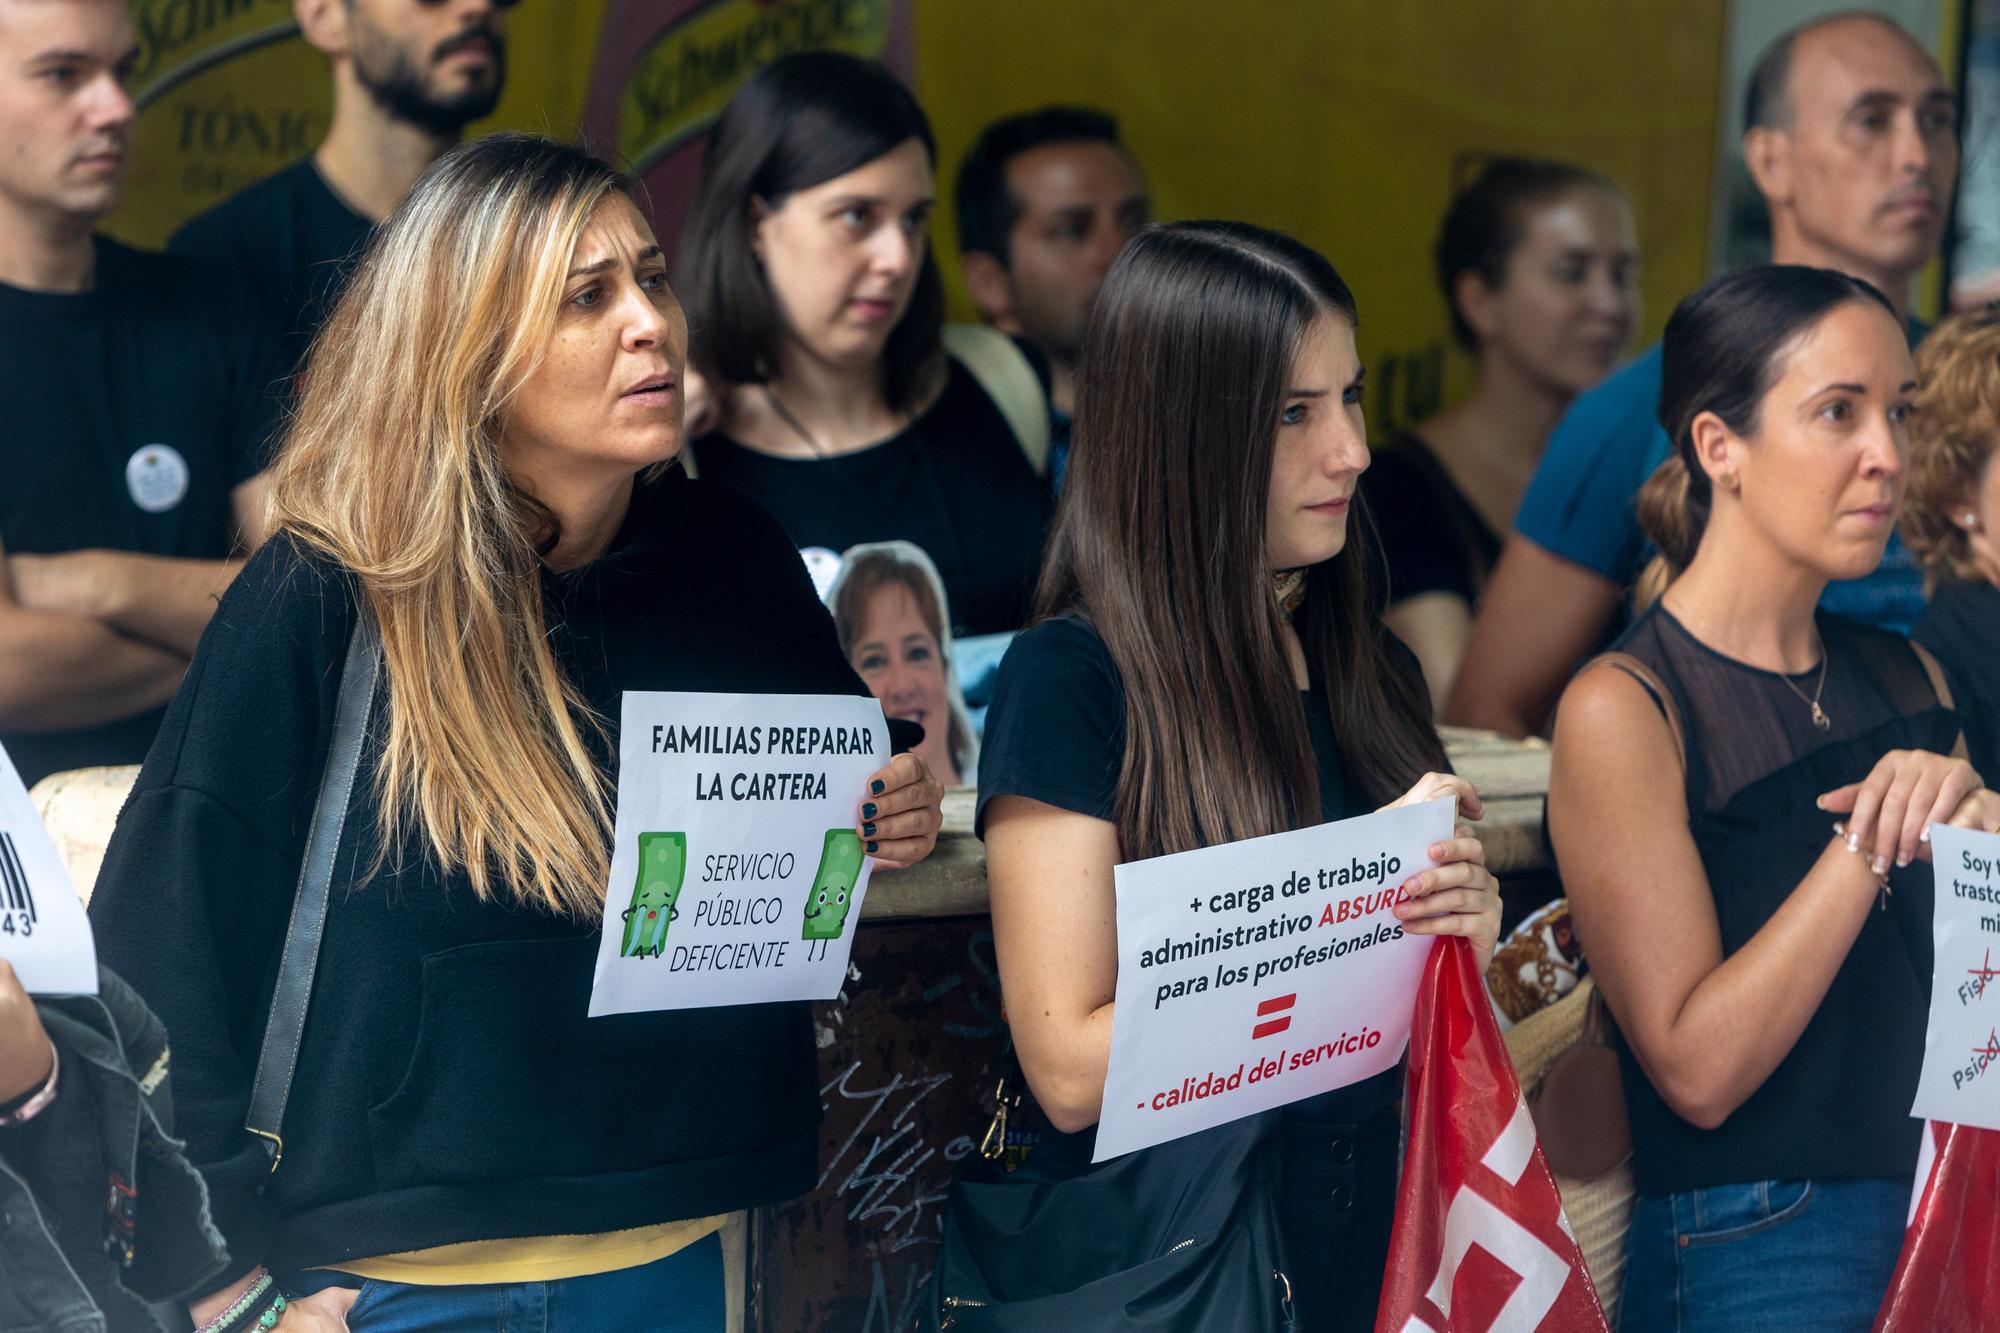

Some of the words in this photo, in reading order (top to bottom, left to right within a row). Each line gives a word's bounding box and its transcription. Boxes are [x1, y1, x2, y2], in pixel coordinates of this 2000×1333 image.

[652, 725, 762, 755] FAMILIAS
[767, 726, 874, 756] PREPARAR
[695, 772, 724, 801] LA
[730, 772, 827, 801] CARTERA
[702, 852, 795, 882] SERVICIO
[1962, 849, 1992, 880] Soy
[1209, 884, 1275, 915] carga
[1281, 871, 1311, 898] de
[1317, 852, 1401, 890] trabajo
[693, 892, 783, 928] PÚBLICO
[669, 941, 789, 972] DEFICIENTE
[1140, 912, 1313, 969] administrativo
[1155, 973, 1209, 1009] para
[1215, 965, 1248, 990] los
[1253, 923, 1404, 986] profesionales
[1152, 1064, 1244, 1112] calidad
[1247, 1050, 1286, 1086] del
[1288, 1025, 1381, 1071] servicio
